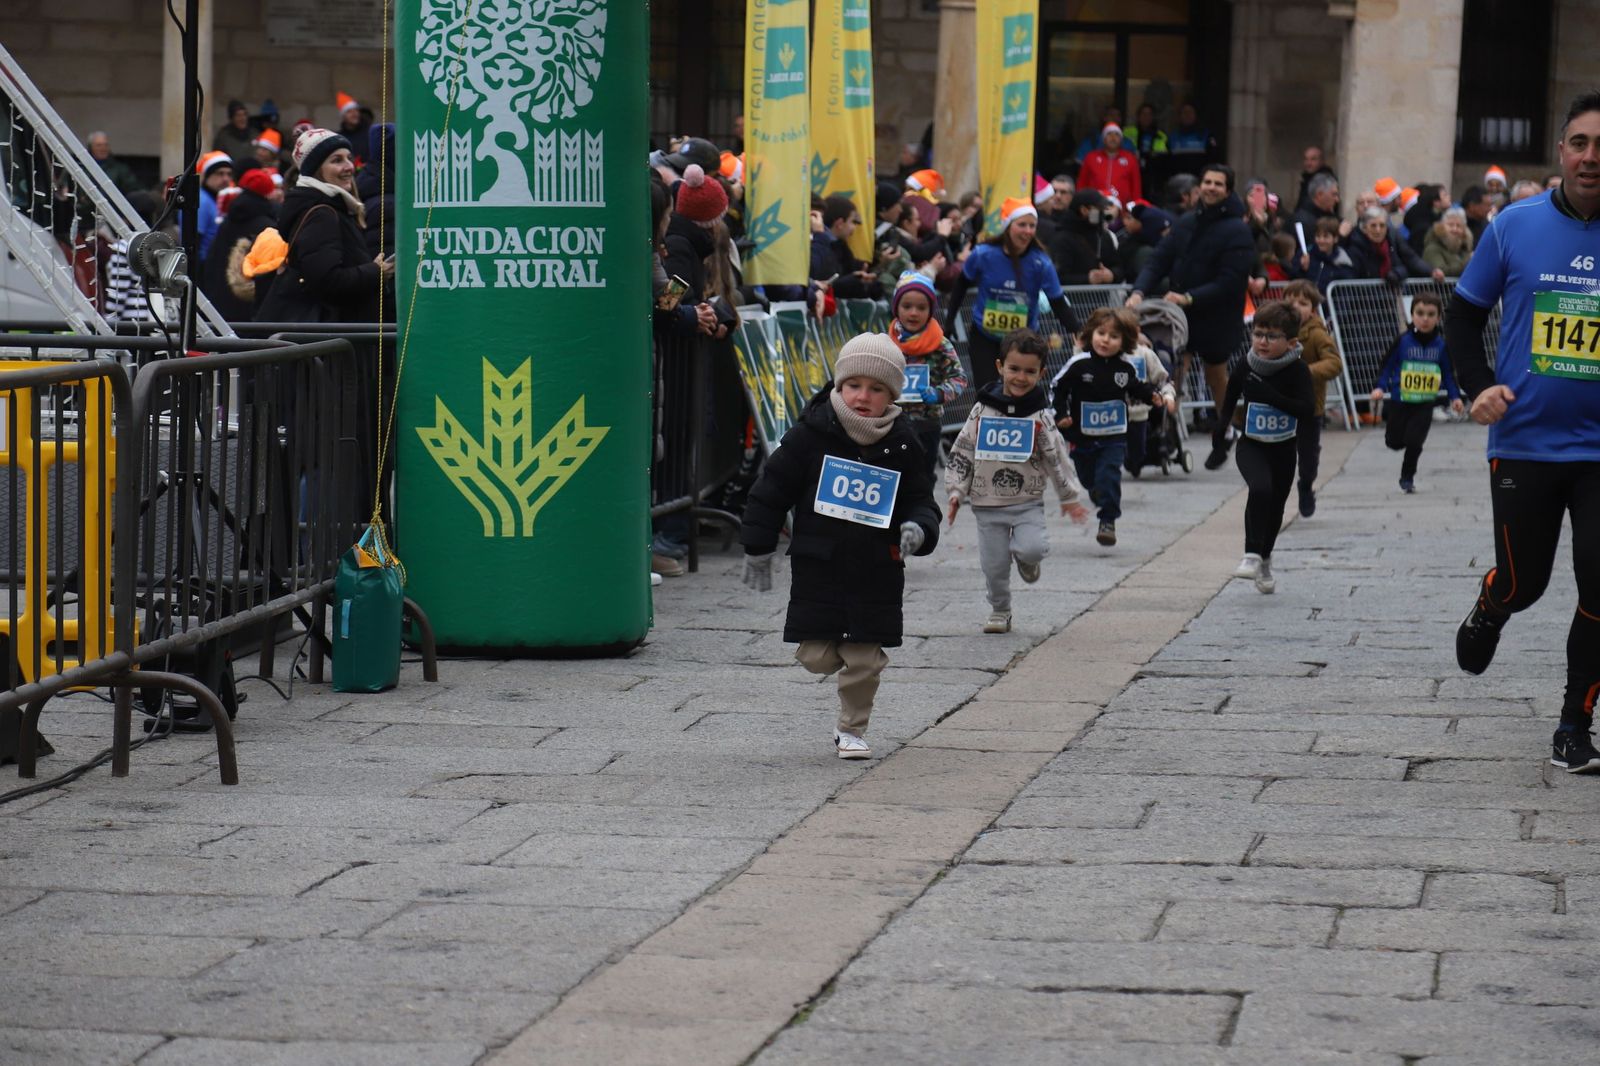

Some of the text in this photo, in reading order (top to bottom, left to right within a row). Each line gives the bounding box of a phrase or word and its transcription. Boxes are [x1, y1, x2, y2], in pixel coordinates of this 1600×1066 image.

[416, 226, 606, 255] FUNDACION
[1570, 255, 1595, 271] 46
[417, 259, 606, 291] CAJA RURAL
[1539, 273, 1556, 282] SAN
[985, 312, 1021, 329] 398
[1542, 316, 1600, 353] 1147
[1553, 361, 1577, 372] CAJA
[1090, 409, 1118, 425] 064
[1255, 414, 1289, 430] 083
[985, 428, 1023, 448] 062
[832, 474, 882, 506] 036
